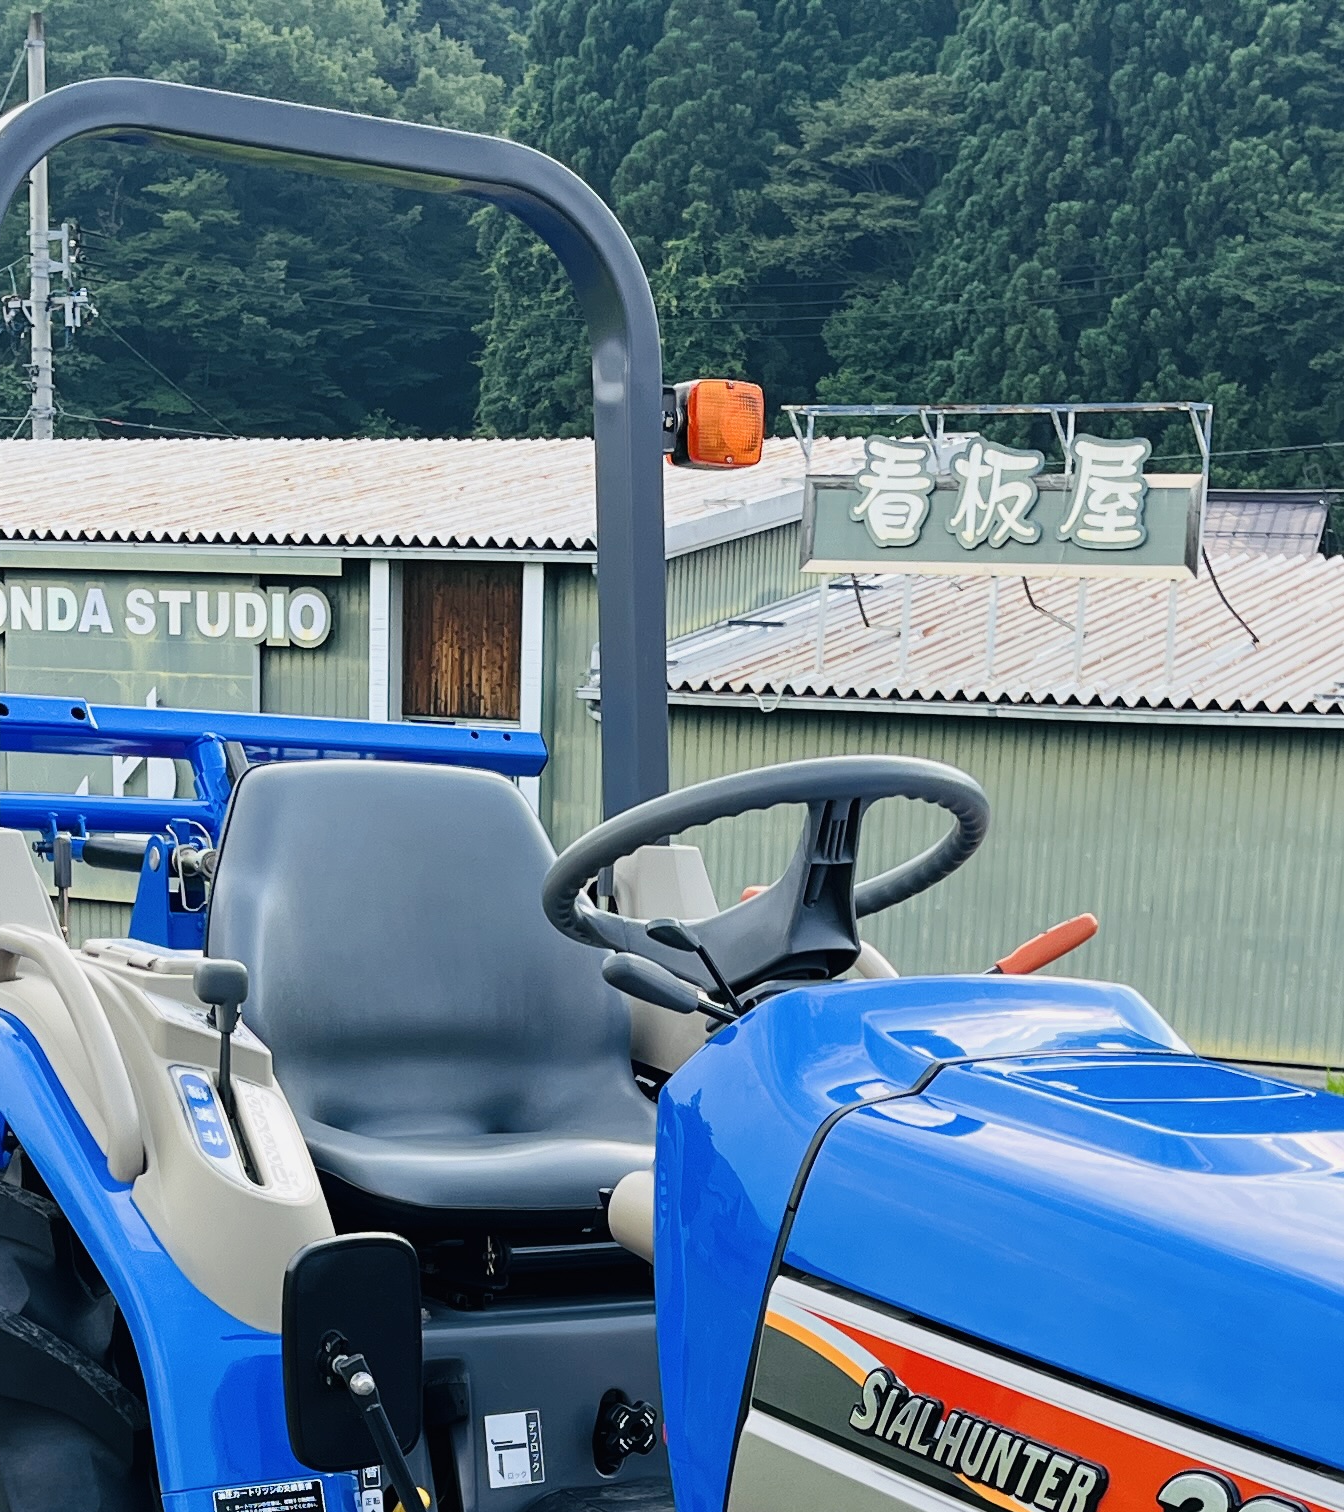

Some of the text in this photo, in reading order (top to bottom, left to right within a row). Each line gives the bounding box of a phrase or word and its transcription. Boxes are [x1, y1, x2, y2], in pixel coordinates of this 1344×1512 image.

[853, 440, 1147, 543] 看板屋
[124, 588, 327, 641] STUDIO
